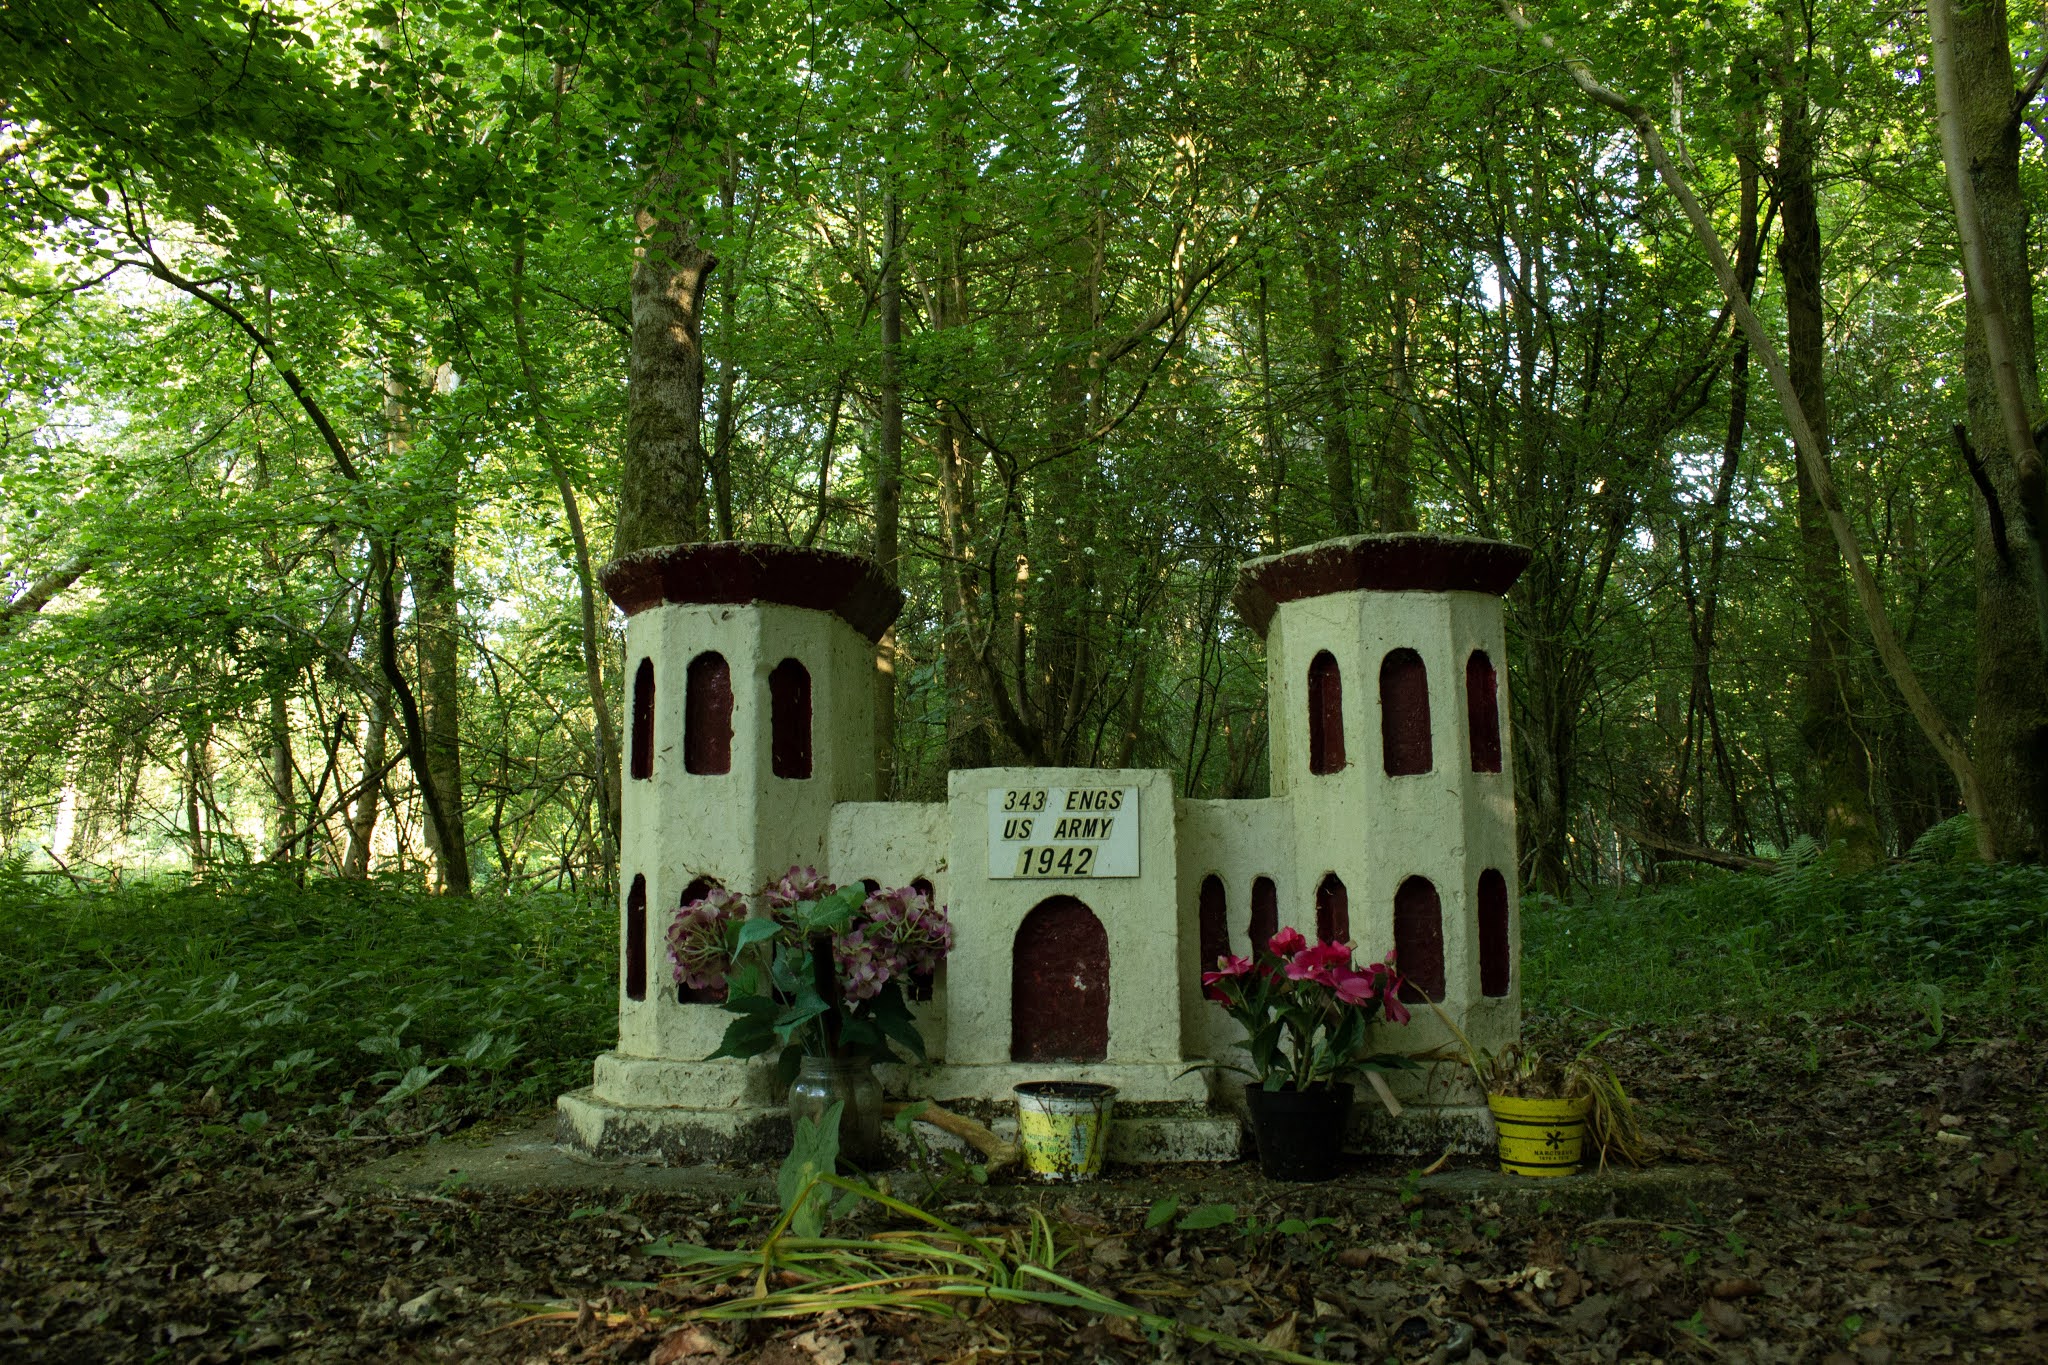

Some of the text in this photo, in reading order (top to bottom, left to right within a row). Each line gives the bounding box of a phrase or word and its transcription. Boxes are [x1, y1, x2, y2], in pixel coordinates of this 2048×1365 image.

[1004, 790, 1123, 811] 343 ENGS
[1003, 818, 1113, 839] US ARMY
[1022, 847, 1093, 875] 1942
